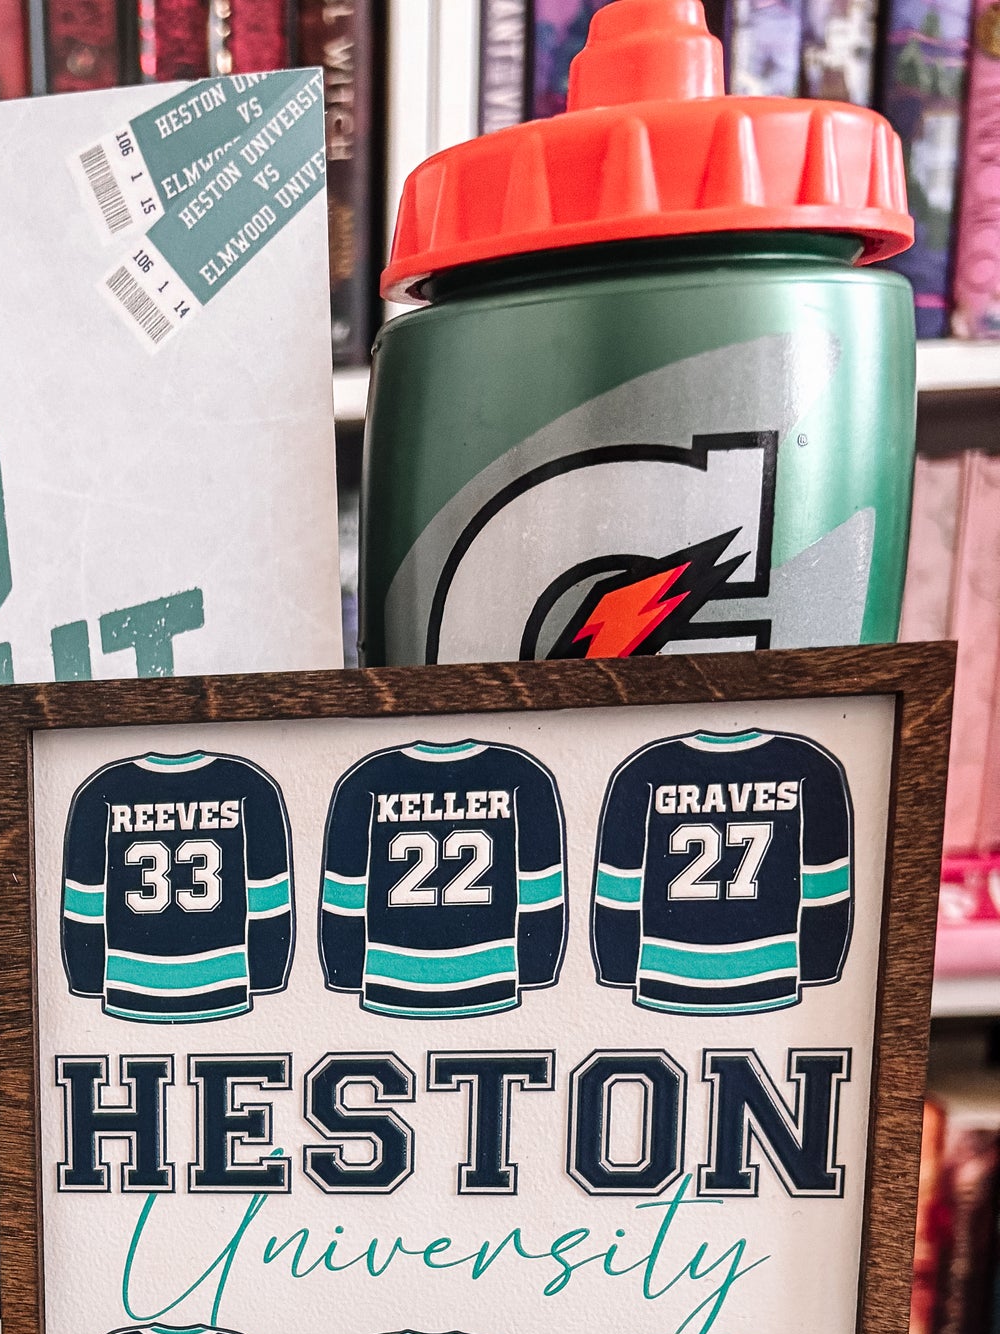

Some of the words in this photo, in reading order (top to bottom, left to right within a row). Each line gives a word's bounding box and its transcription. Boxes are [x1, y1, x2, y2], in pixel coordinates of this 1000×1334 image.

[154, 83, 227, 139] HESTON
[237, 96, 263, 124] VS
[115, 130, 134, 157] 106
[130, 171, 143, 183] 1
[140, 197, 157, 215] 15
[178, 161, 243, 231] HESTON
[252, 163, 280, 193] VS
[199, 205, 277, 286] ELMWOOD
[274, 146, 326, 209] UNIVE
[132, 249, 155, 273] 106
[157, 280, 170, 293] 1
[173, 299, 191, 319] 14
[111, 800, 240, 833] REEVES
[377, 788, 511, 823] KELLER
[654, 781, 799, 815] GRAVES
[124, 839, 223, 914] 33
[387, 828, 494, 909] 22
[667, 821, 775, 902] 27
[54, 1047, 853, 1198] HESTON
